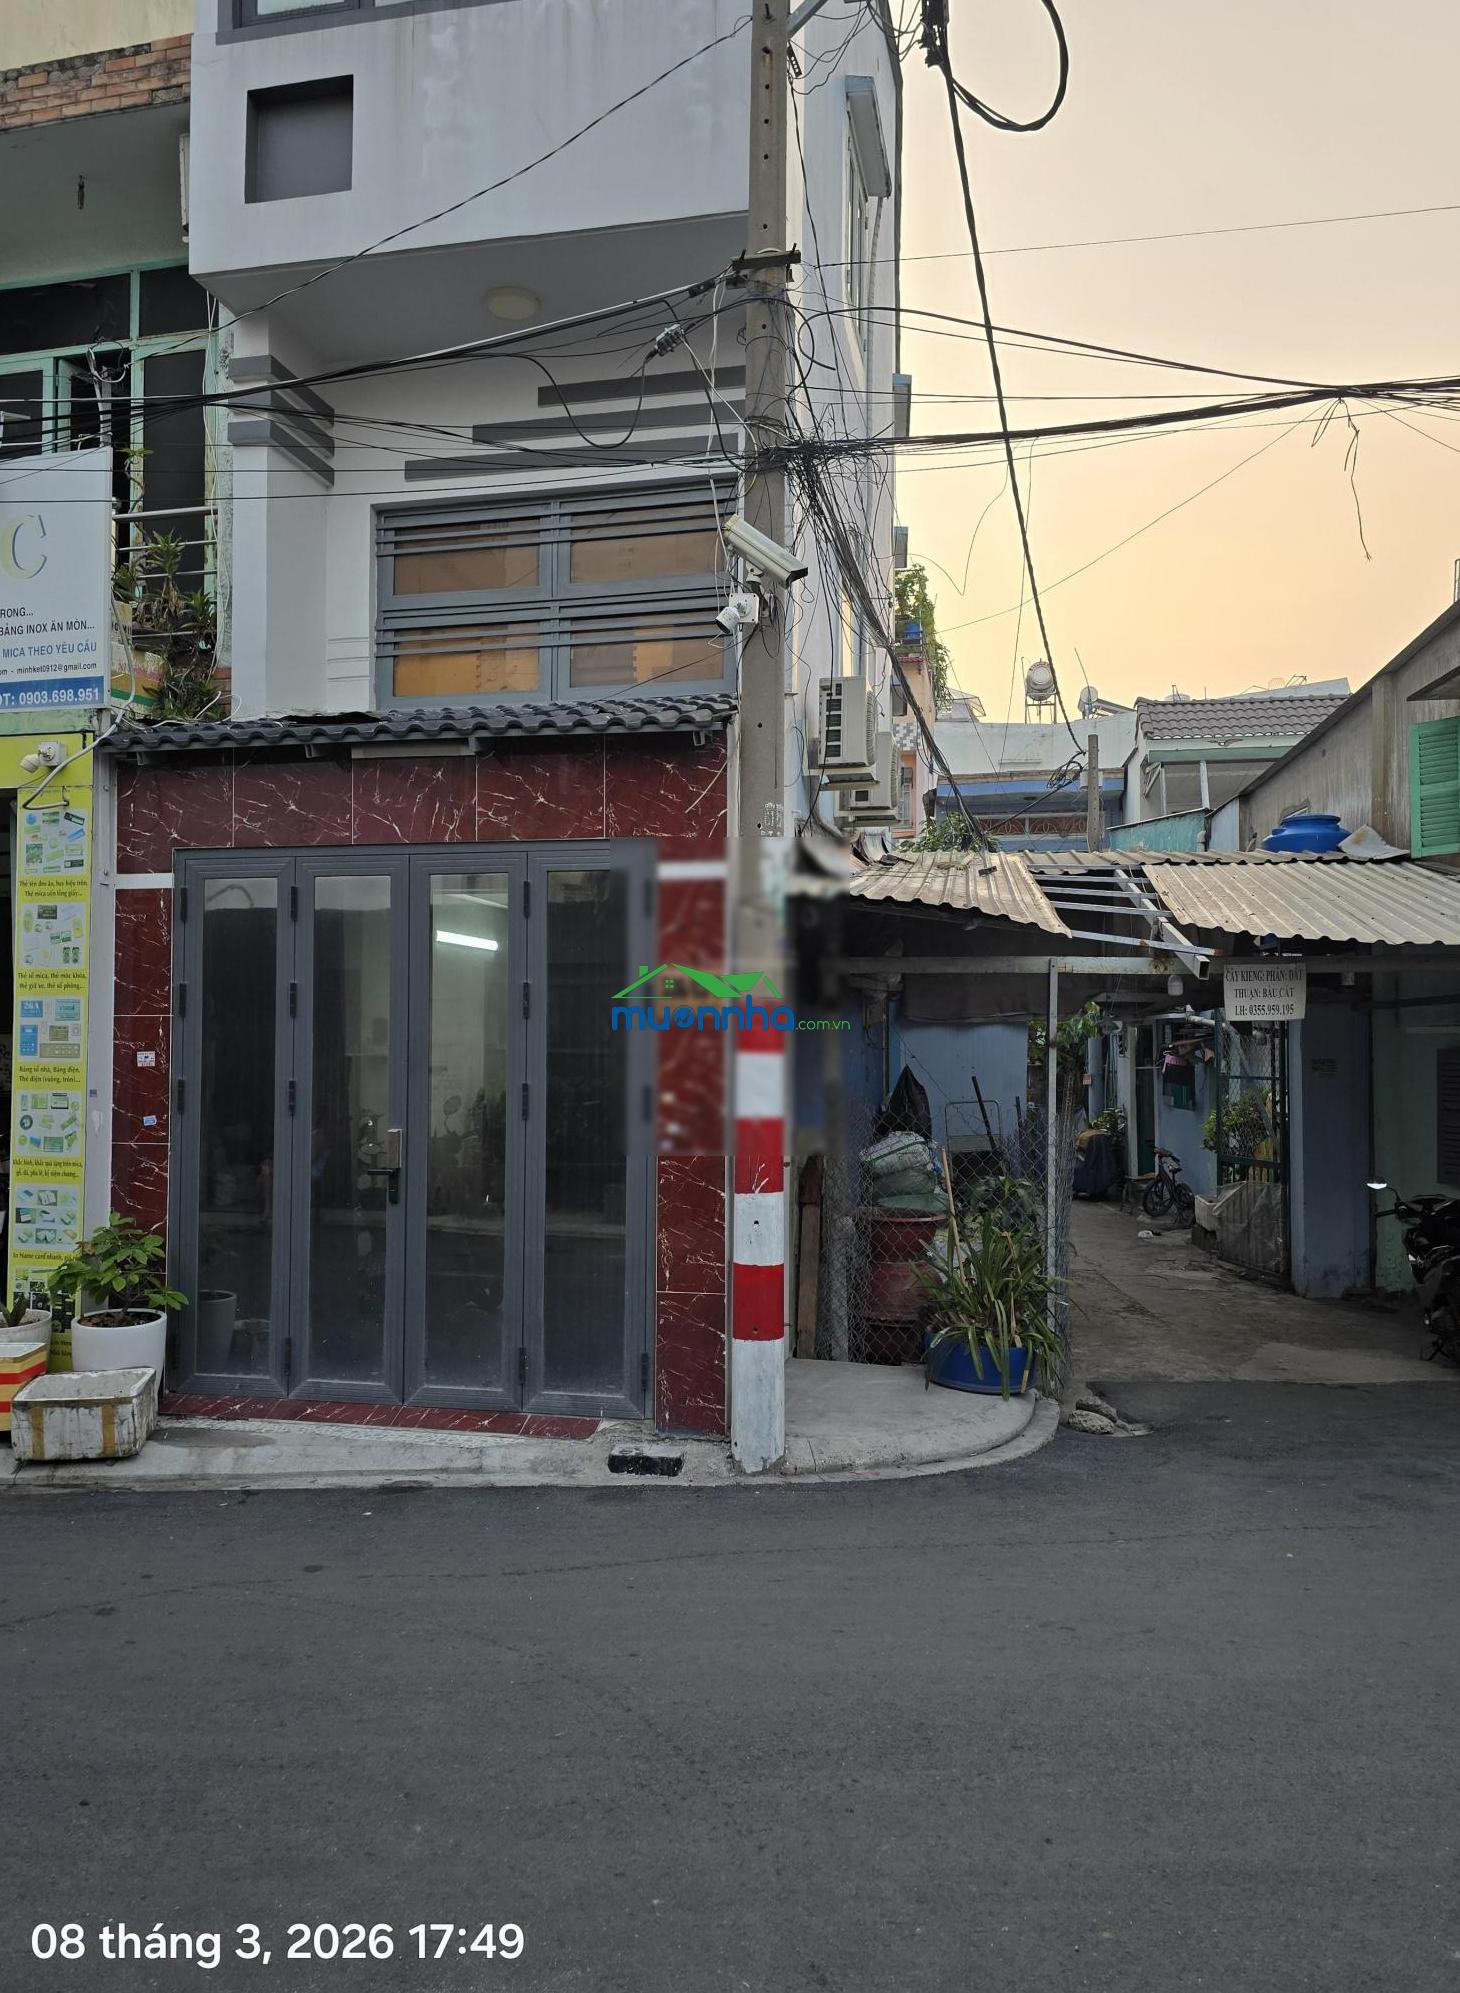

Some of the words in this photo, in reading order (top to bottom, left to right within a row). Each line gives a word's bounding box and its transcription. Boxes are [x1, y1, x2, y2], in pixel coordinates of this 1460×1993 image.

[0, 515, 47, 579] C
[26, 623, 47, 634] INOX
[50, 619, 63, 632] ĂN
[3, 647, 25, 658] MICA
[28, 645, 53, 656] THEO
[56, 641, 74, 654] YÊU
[19, 688, 99, 705] 0903.698.951
[1235, 1004, 1248, 1016] LH:
